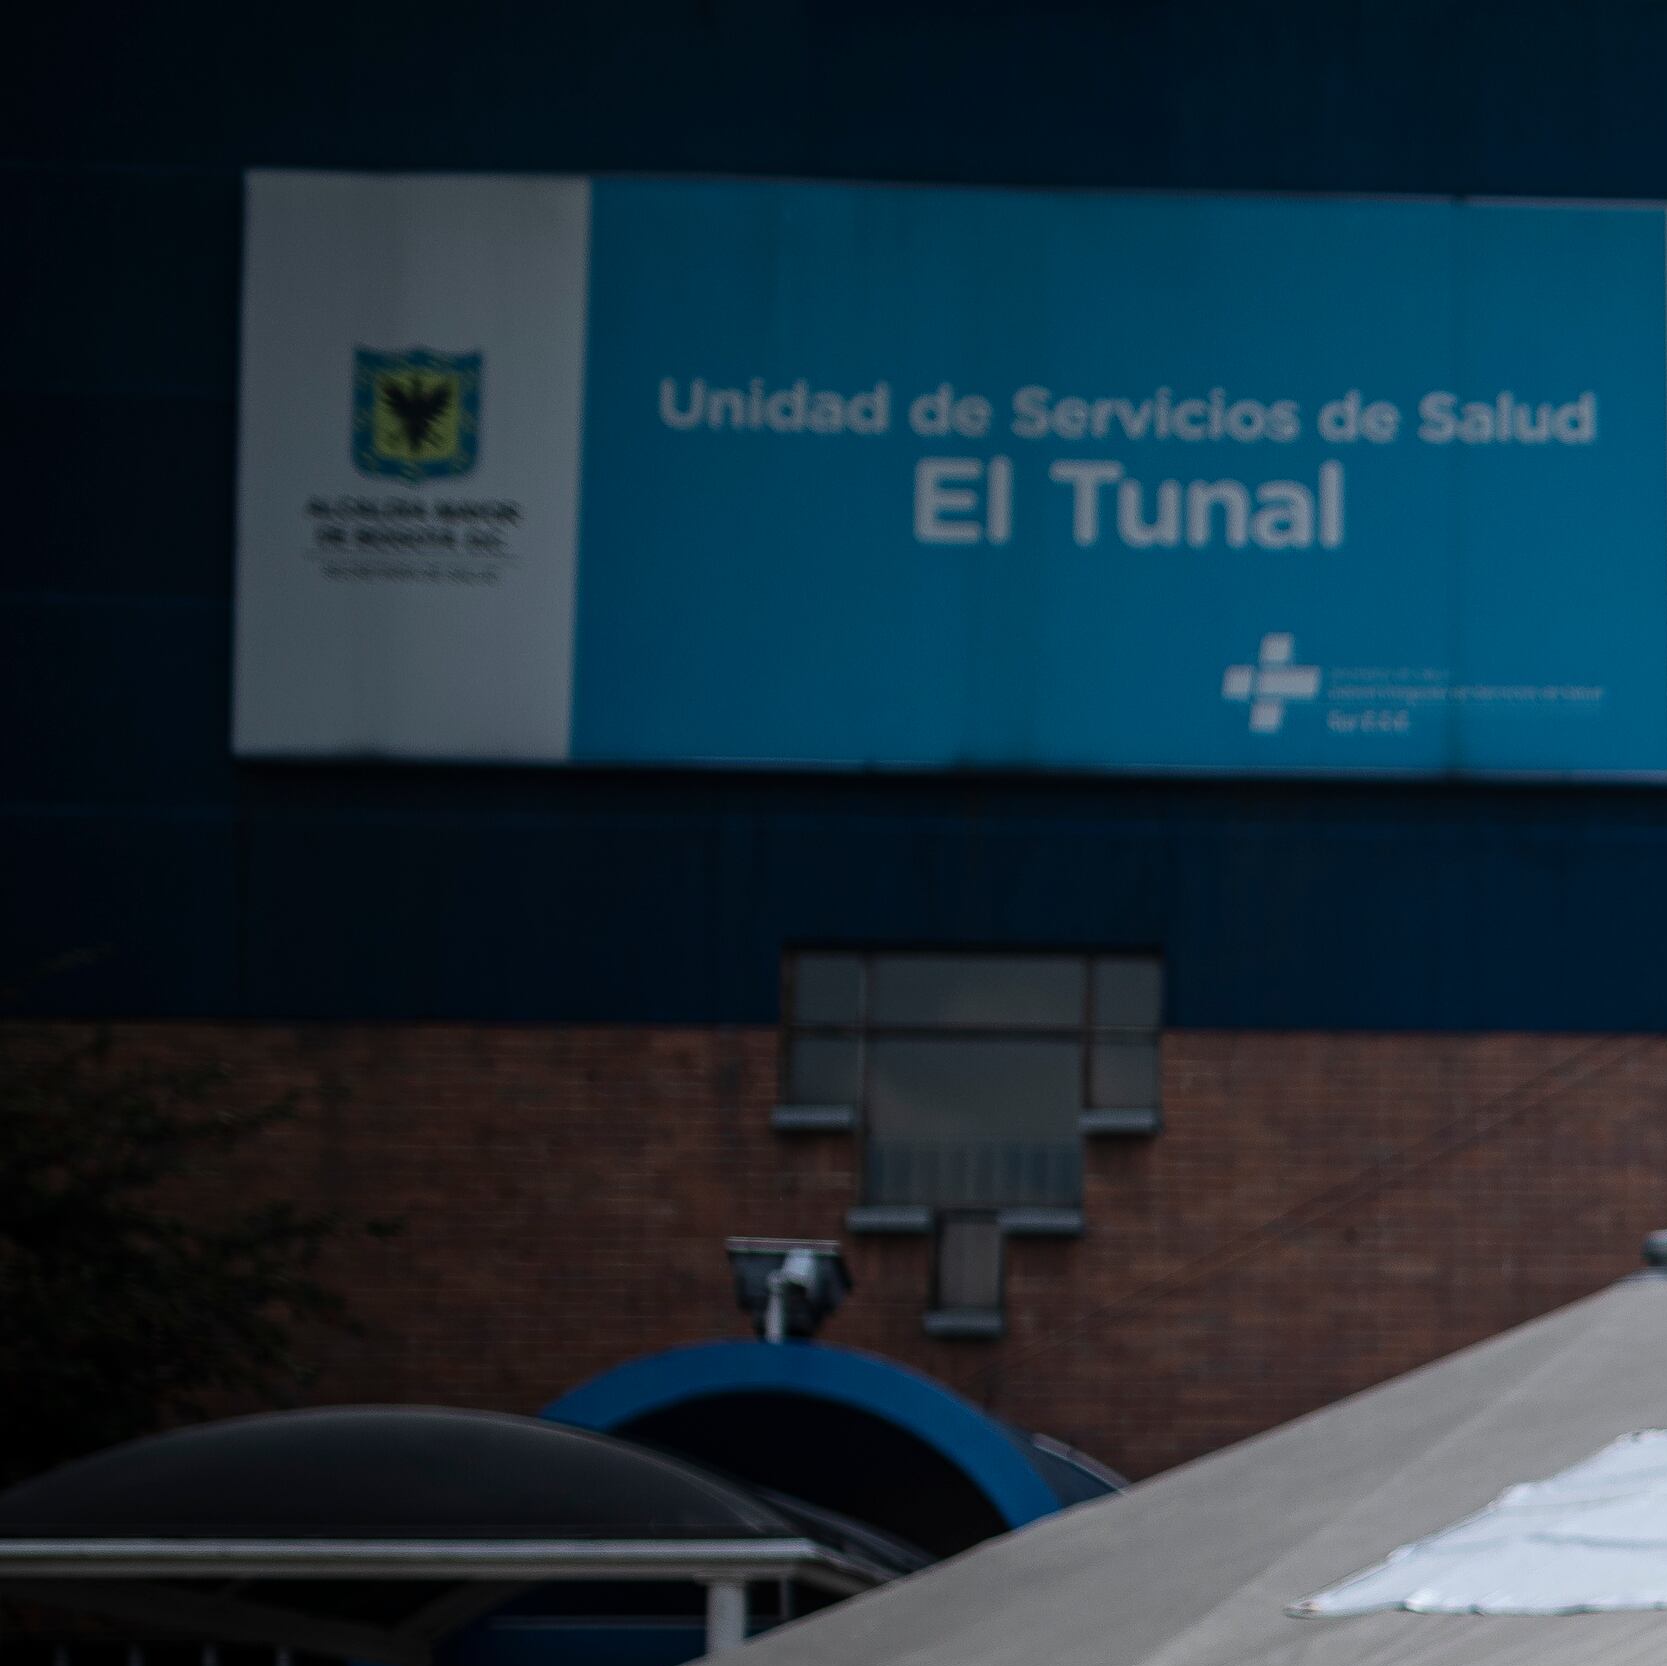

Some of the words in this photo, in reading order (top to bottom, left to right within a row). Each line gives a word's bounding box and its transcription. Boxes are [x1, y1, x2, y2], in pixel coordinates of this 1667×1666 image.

[659, 377, 891, 433] Unidad
[908, 383, 993, 437] de
[1010, 385, 1300, 443] Servicios
[1318, 388, 1400, 444] de
[1417, 390, 1597, 444] Salud
[913, 455, 1013, 546] El
[1049, 459, 1345, 550] Tunal
